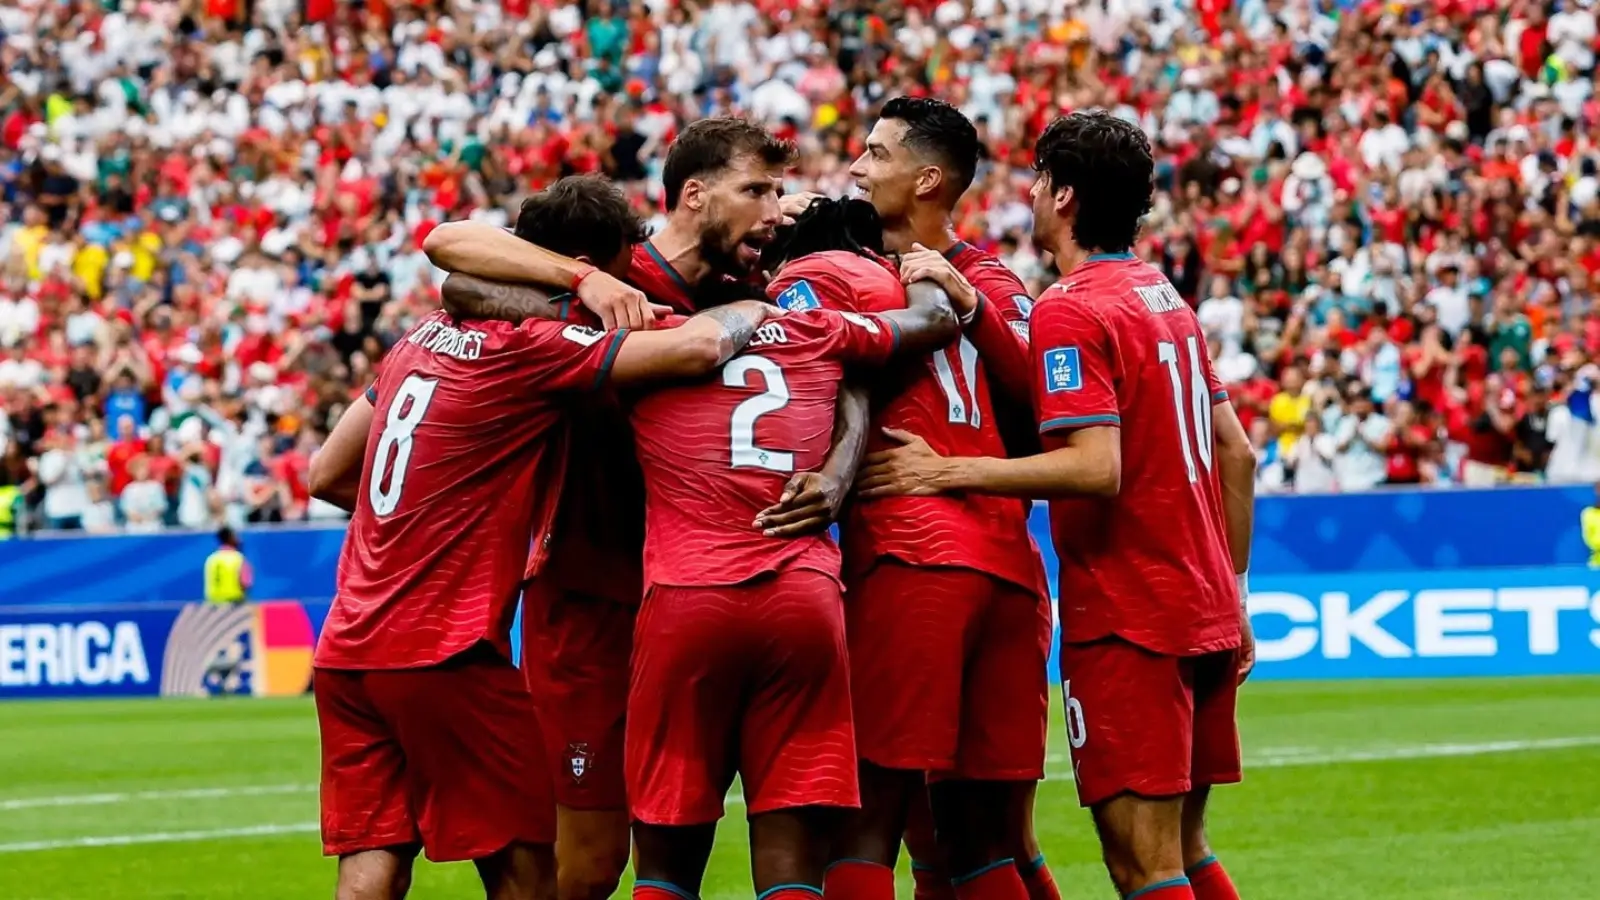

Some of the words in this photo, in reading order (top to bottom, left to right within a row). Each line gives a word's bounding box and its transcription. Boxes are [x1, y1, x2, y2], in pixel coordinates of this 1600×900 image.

[369, 373, 440, 516] 8
[722, 353, 794, 472] 2
[1157, 336, 1212, 484] 16
[0, 620, 150, 686] ERICA
[1246, 585, 1600, 663] CKET
